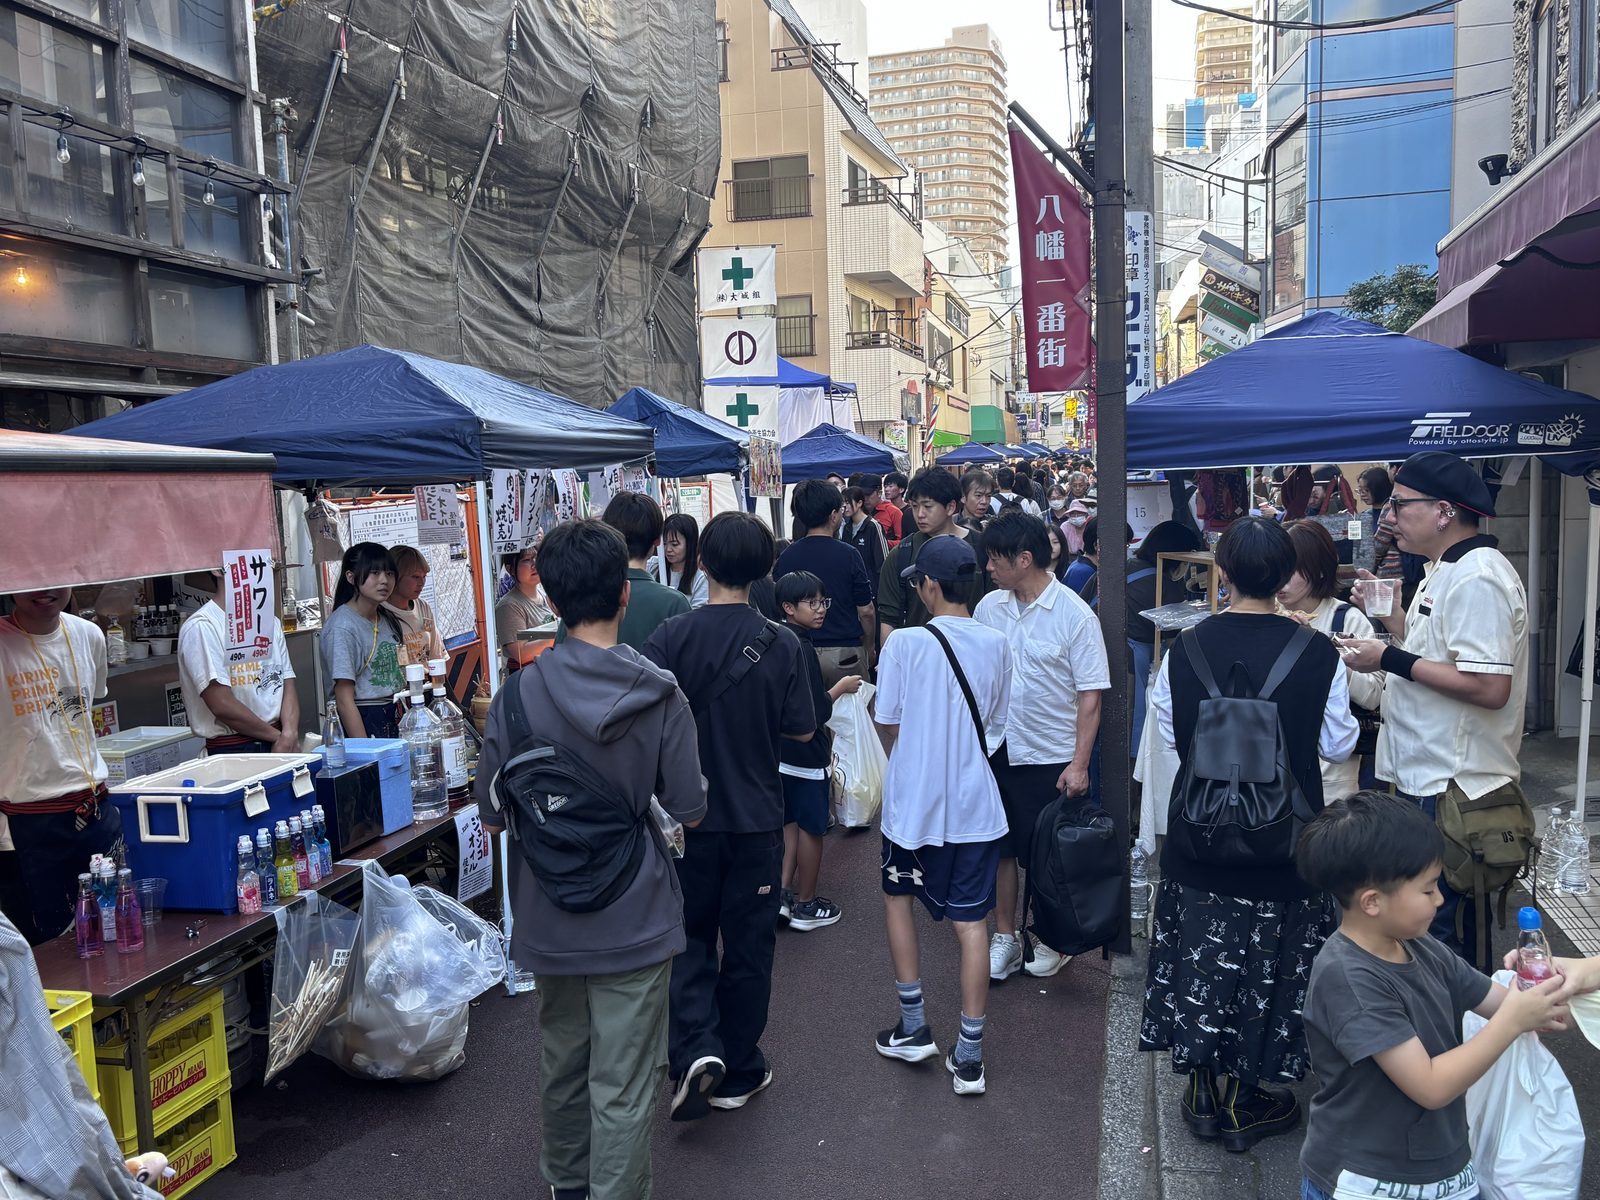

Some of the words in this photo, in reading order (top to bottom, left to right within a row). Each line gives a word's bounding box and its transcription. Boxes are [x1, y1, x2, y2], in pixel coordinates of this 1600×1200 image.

[1035, 194, 1066, 369] 八幡一番街
[1432, 424, 1509, 438] FIELDOOR
[1408, 438, 1444, 446] Powered
[1135, 507, 1146, 518] 15
[250, 554, 267, 635] サワー
[230, 652, 245, 661] 490円
[230, 662, 261, 673] PRIME
[1502, 831, 1515, 843] US
[267, 877, 275, 899] ラムネ
[152, 1063, 187, 1099] HOPPY
[187, 1059, 205, 1077] BRAND
[193, 1147, 210, 1164] BRAND
[1372, 1179, 1430, 1200] FULL
[1435, 1177, 1456, 1199] OF
